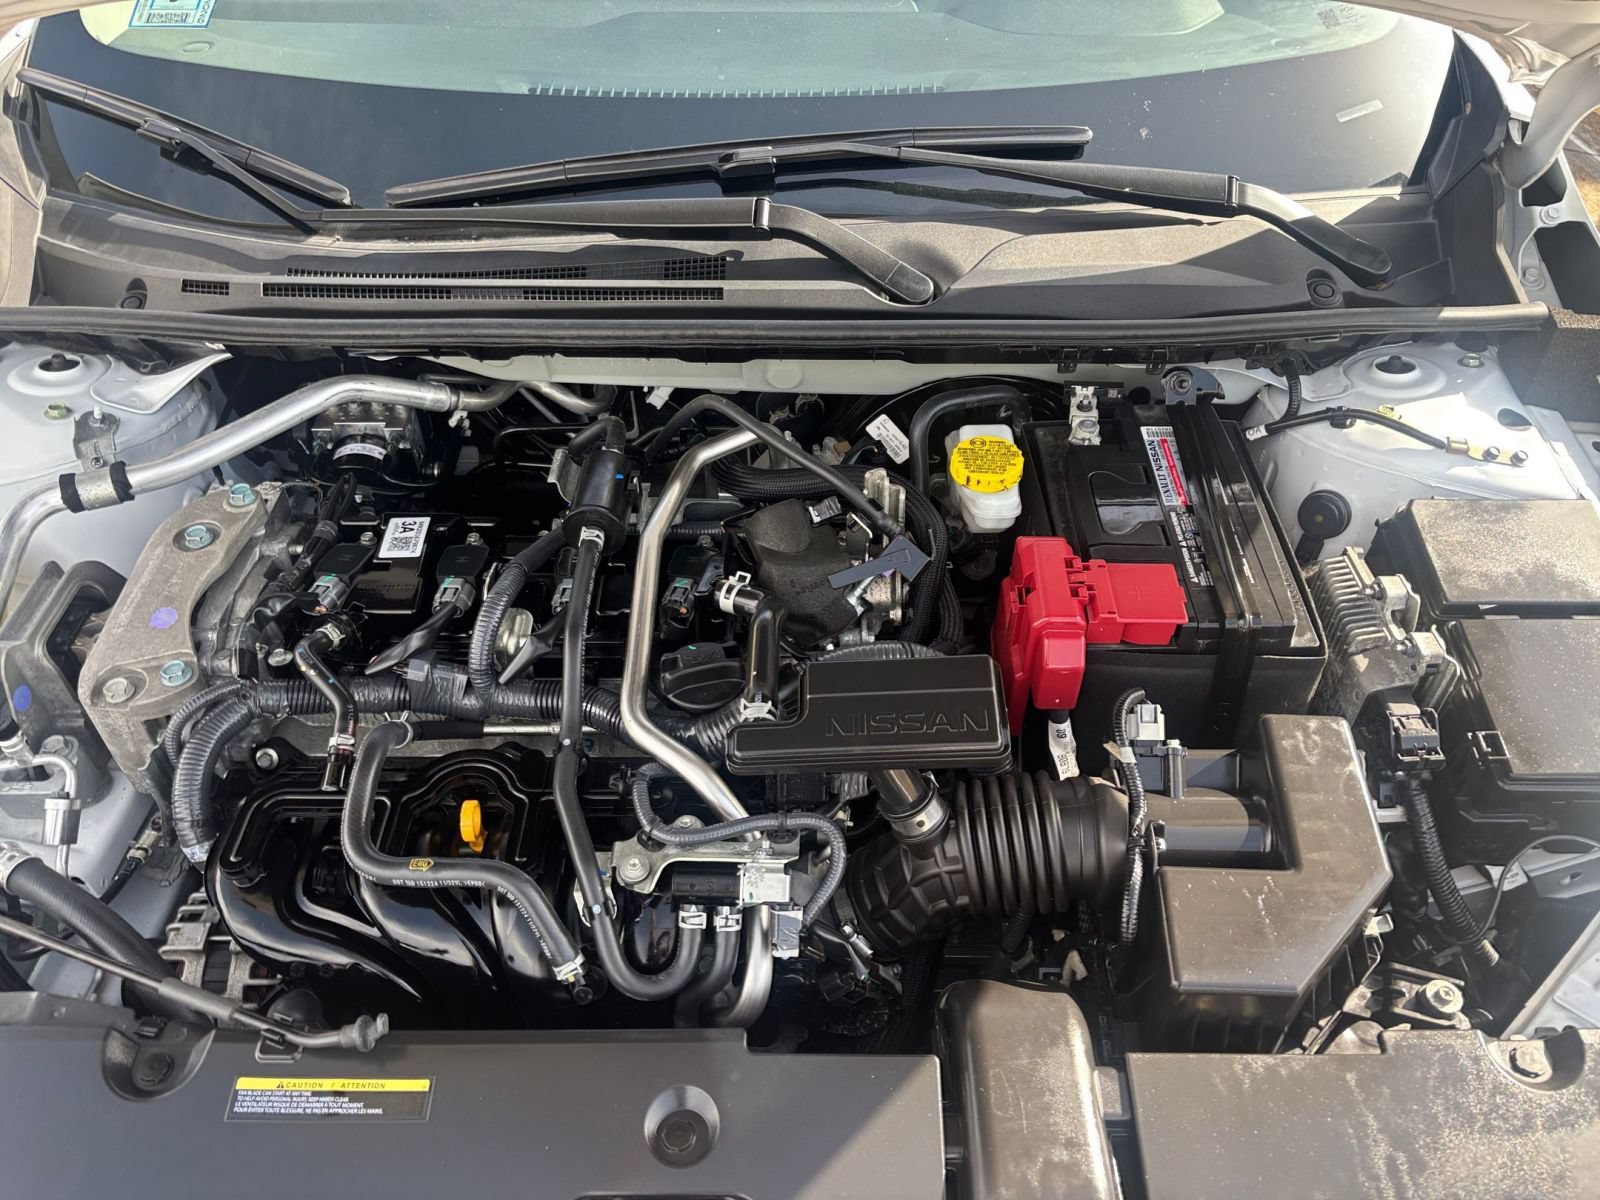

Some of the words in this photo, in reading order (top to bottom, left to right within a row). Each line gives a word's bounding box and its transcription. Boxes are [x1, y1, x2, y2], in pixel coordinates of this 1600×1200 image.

[1146, 439, 1164, 472] NISSAN
[1157, 473, 1175, 504] RENAULT
[399, 520, 417, 534] 3A
[824, 708, 989, 737] NISSAN
